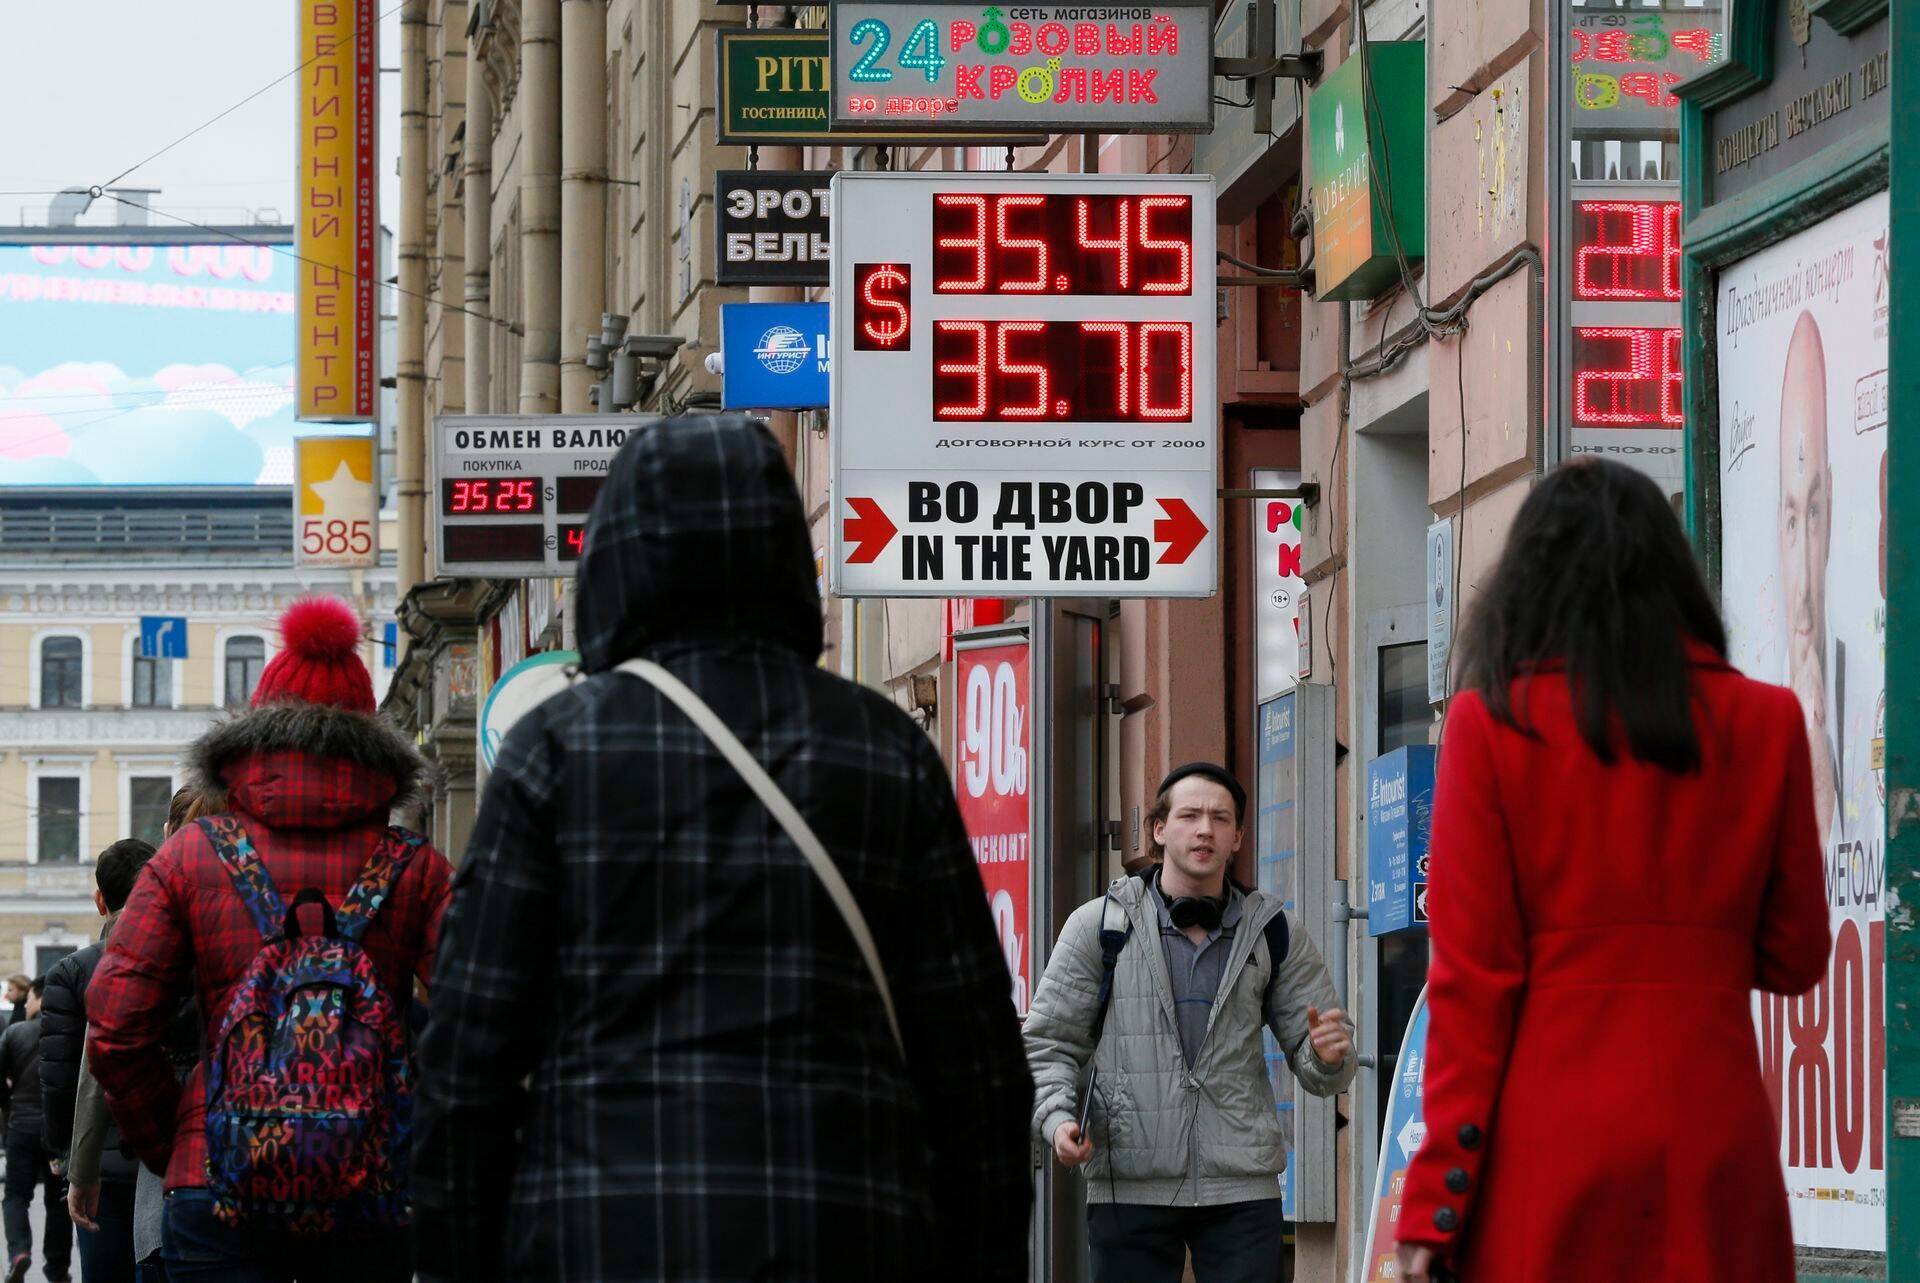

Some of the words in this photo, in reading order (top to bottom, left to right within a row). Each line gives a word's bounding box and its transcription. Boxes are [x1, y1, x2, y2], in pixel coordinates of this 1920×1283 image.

[949, 12, 1178, 56] РОЗОВЫЙ
[1010, 7, 1048, 20] сеть
[1054, 7, 1152, 20] магазинов
[849, 18, 946, 83] 24
[955, 62, 1159, 105] КРОЛИК
[741, 106, 827, 120] ГОСТИНИЦА
[1716, 111, 1779, 174] КОНЦЕРТЫ
[1784, 72, 1852, 139] ВЫСТАВКИ
[1314, 152, 1367, 224] ДОВЕРИЕ
[937, 195, 1190, 292] 35.45
[864, 265, 908, 346] $
[1727, 262, 1802, 349] Праздничный
[1805, 245, 1855, 303] концерт
[313, 264, 341, 408] ЦЕНТР
[757, 351, 808, 360] ИНТУРИСТ
[937, 322, 1190, 417] 35.70
[455, 430, 541, 448] ОБМЕН
[936, 438, 1071, 448] ДОГОВОРНОЙ
[1078, 440, 1126, 448] КУРС
[1131, 440, 1156, 448] ОТ
[1162, 440, 1205, 448] 2000
[463, 460, 522, 471] ПОКУПКА
[574, 459, 614, 472] ПРОД
[908, 481, 979, 524] ВО
[993, 481, 1144, 530] ДВОР
[303, 520, 372, 555] 585
[902, 535, 943, 580] IN
[955, 535, 1032, 580] THE
[1042, 535, 1150, 580] YARD
[1273, 595, 1288, 603] 18+
[1380, 771, 1405, 806] Intourist
[968, 832, 1027, 863] ИСКОНТ
